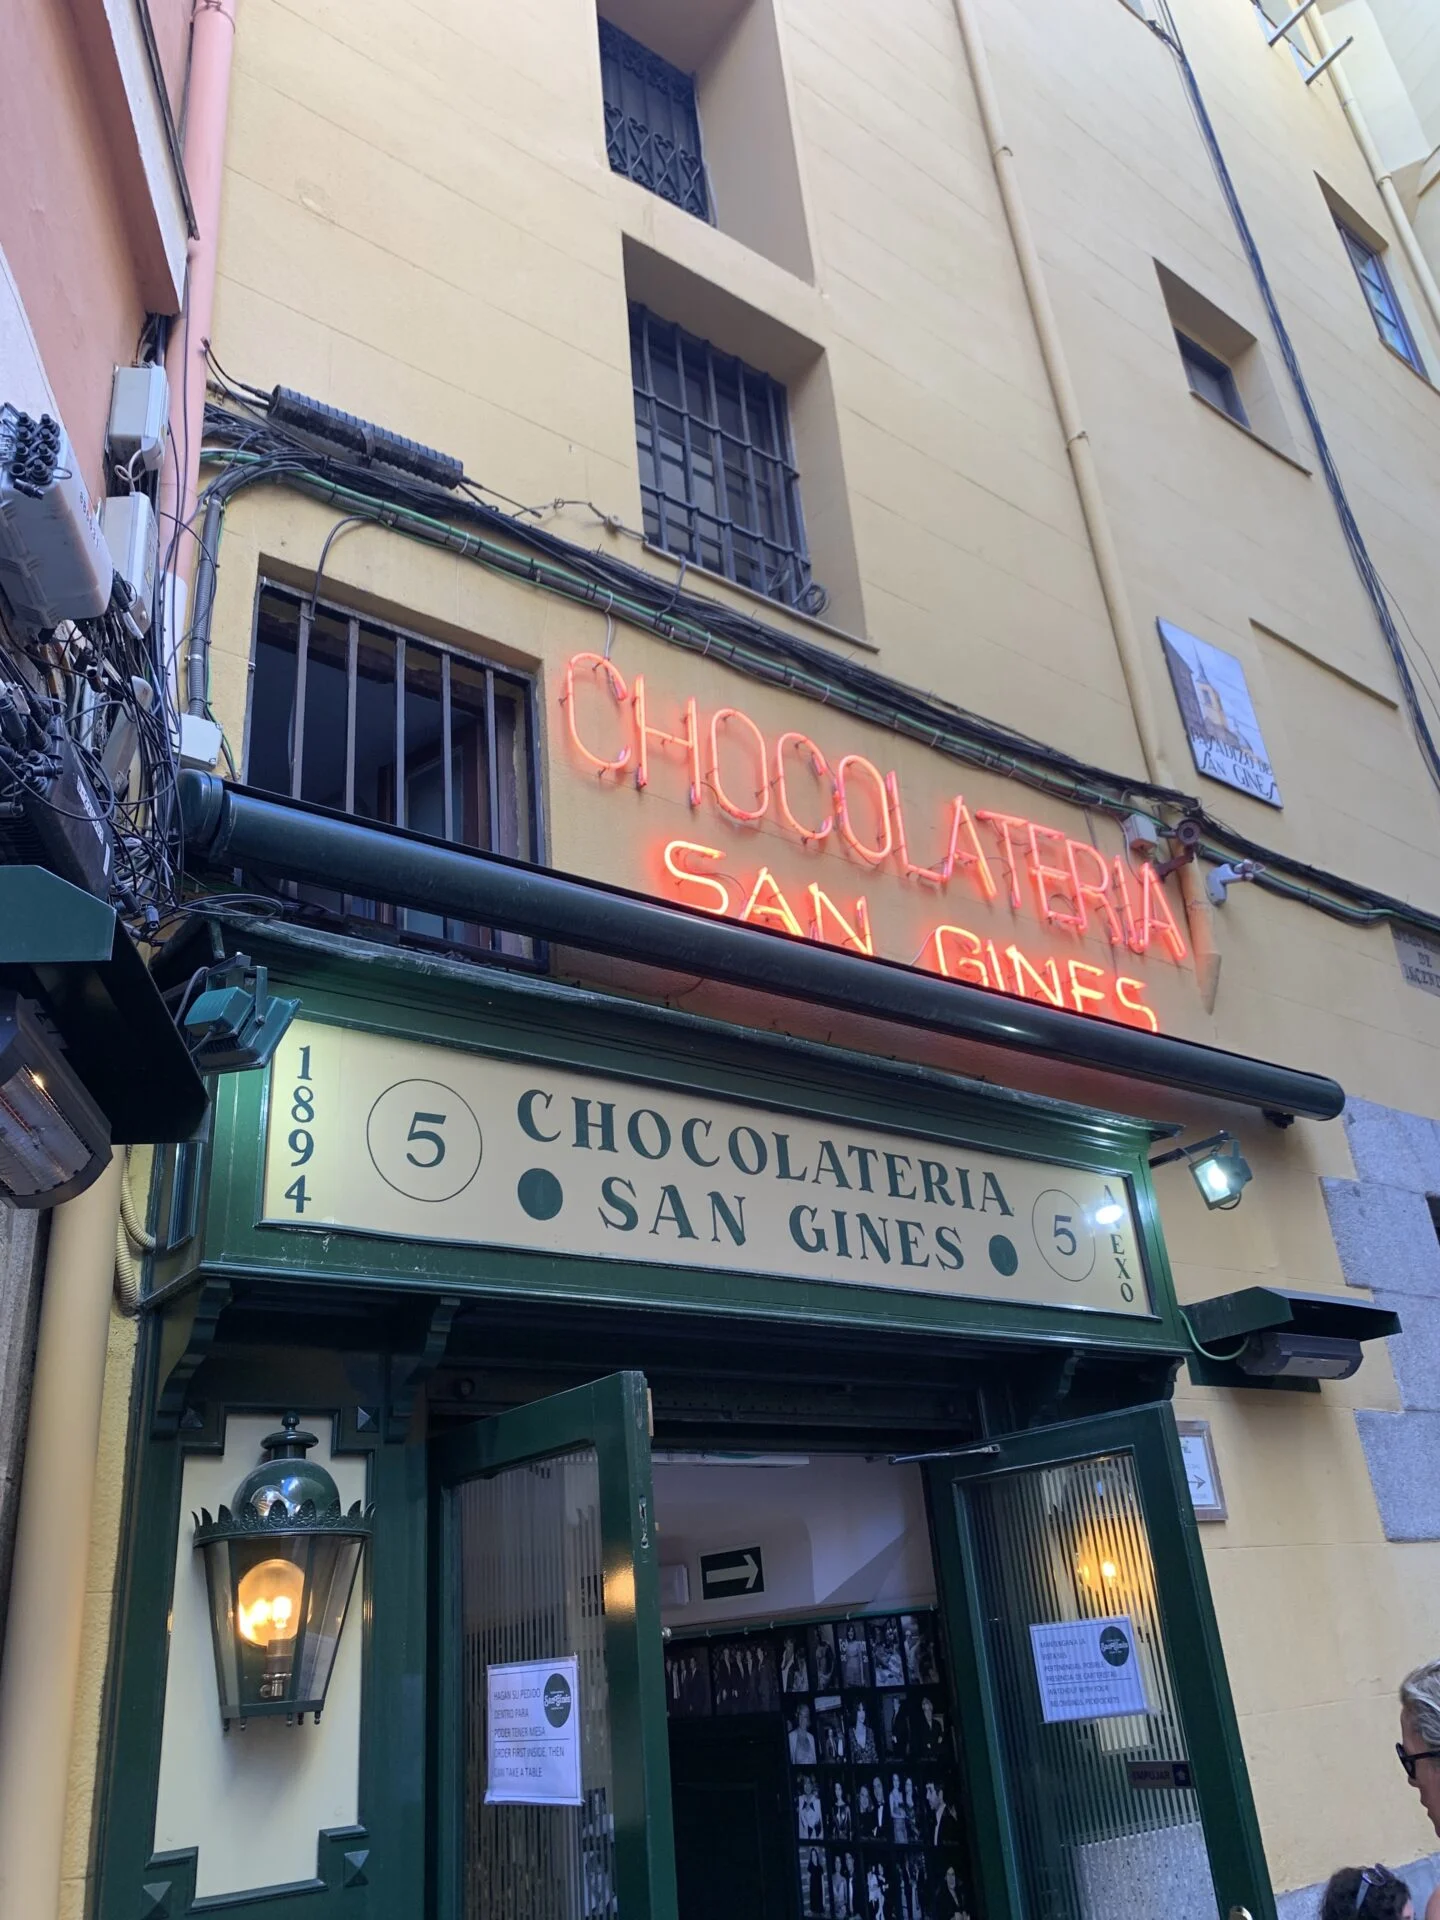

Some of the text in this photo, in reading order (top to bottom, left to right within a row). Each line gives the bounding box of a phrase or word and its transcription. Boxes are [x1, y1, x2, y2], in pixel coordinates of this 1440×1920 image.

[566, 652, 1185, 960] CHOCOLATERIA
[1201, 751, 1227, 776] SAN
[664, 840, 1158, 1034] SAN GINES
[284, 1045, 315, 1214] 1894
[406, 1112, 447, 1168] 5
[517, 1088, 1015, 1217] CHOCOLATERIA
[598, 1176, 965, 1272] SAN GINES
[1052, 1215, 1078, 1257] 5
[1103, 1184, 1134, 1303] AEXO
